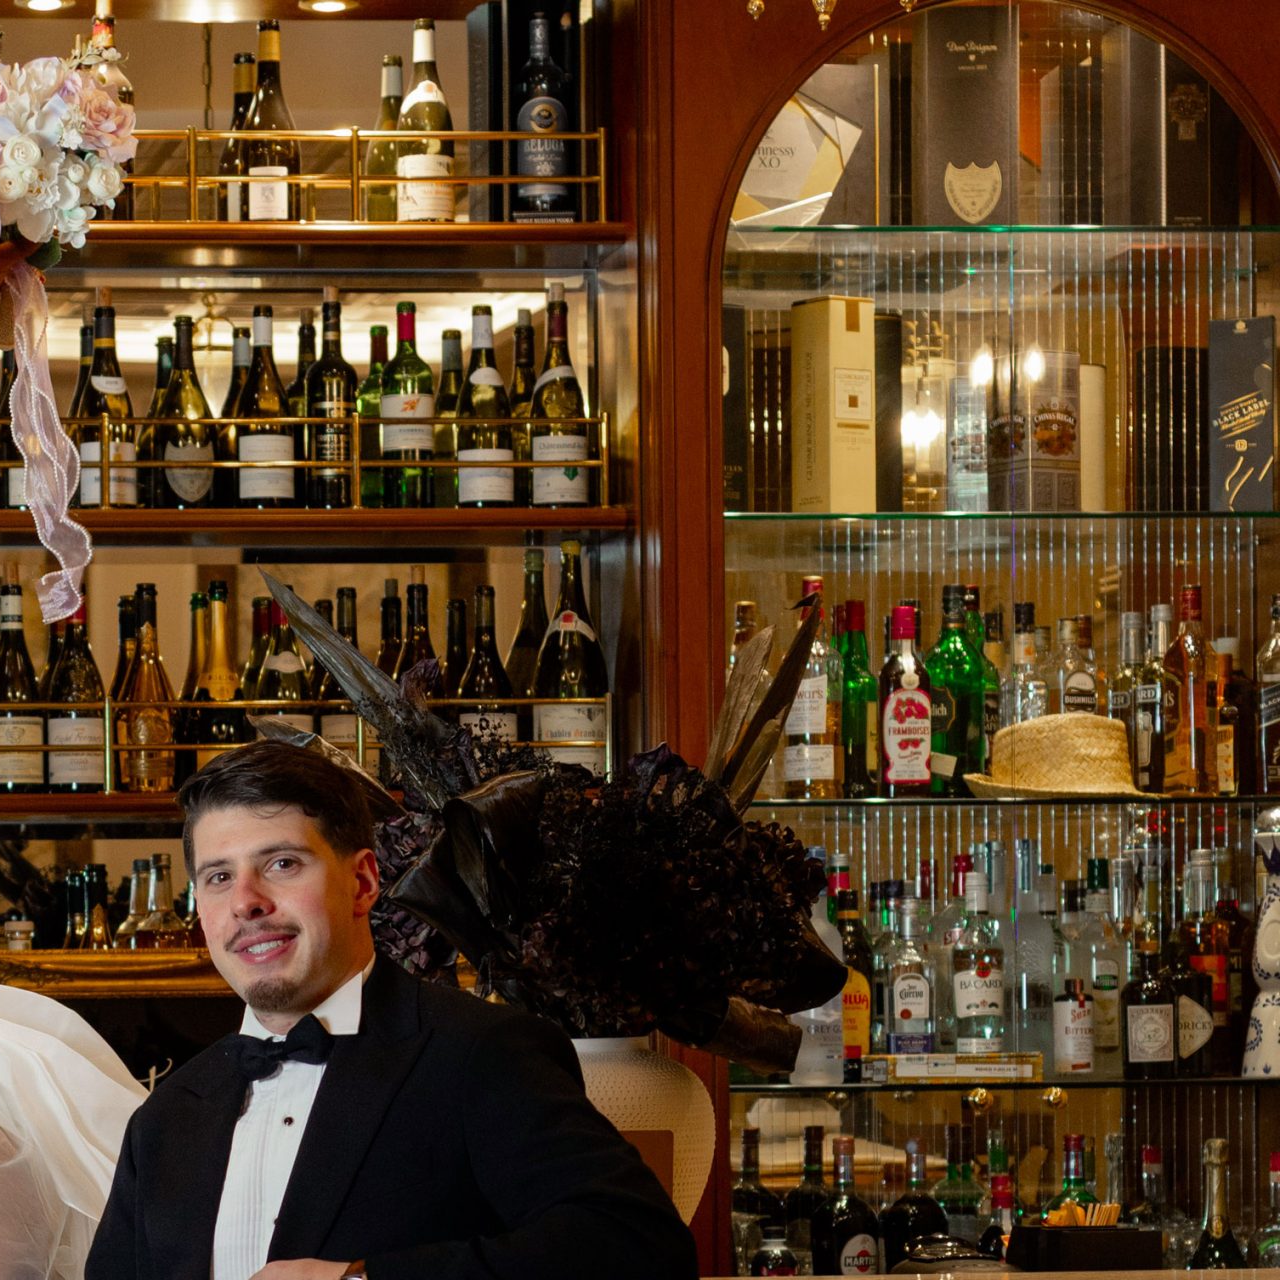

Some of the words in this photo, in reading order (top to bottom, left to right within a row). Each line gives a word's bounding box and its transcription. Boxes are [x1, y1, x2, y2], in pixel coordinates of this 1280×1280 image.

[1064, 695, 1096, 705] BUSHMILLS
[888, 726, 930, 737] FRAMBOISES
[899, 988, 924, 1001] Cuervo
[807, 1024, 830, 1034] GREY
